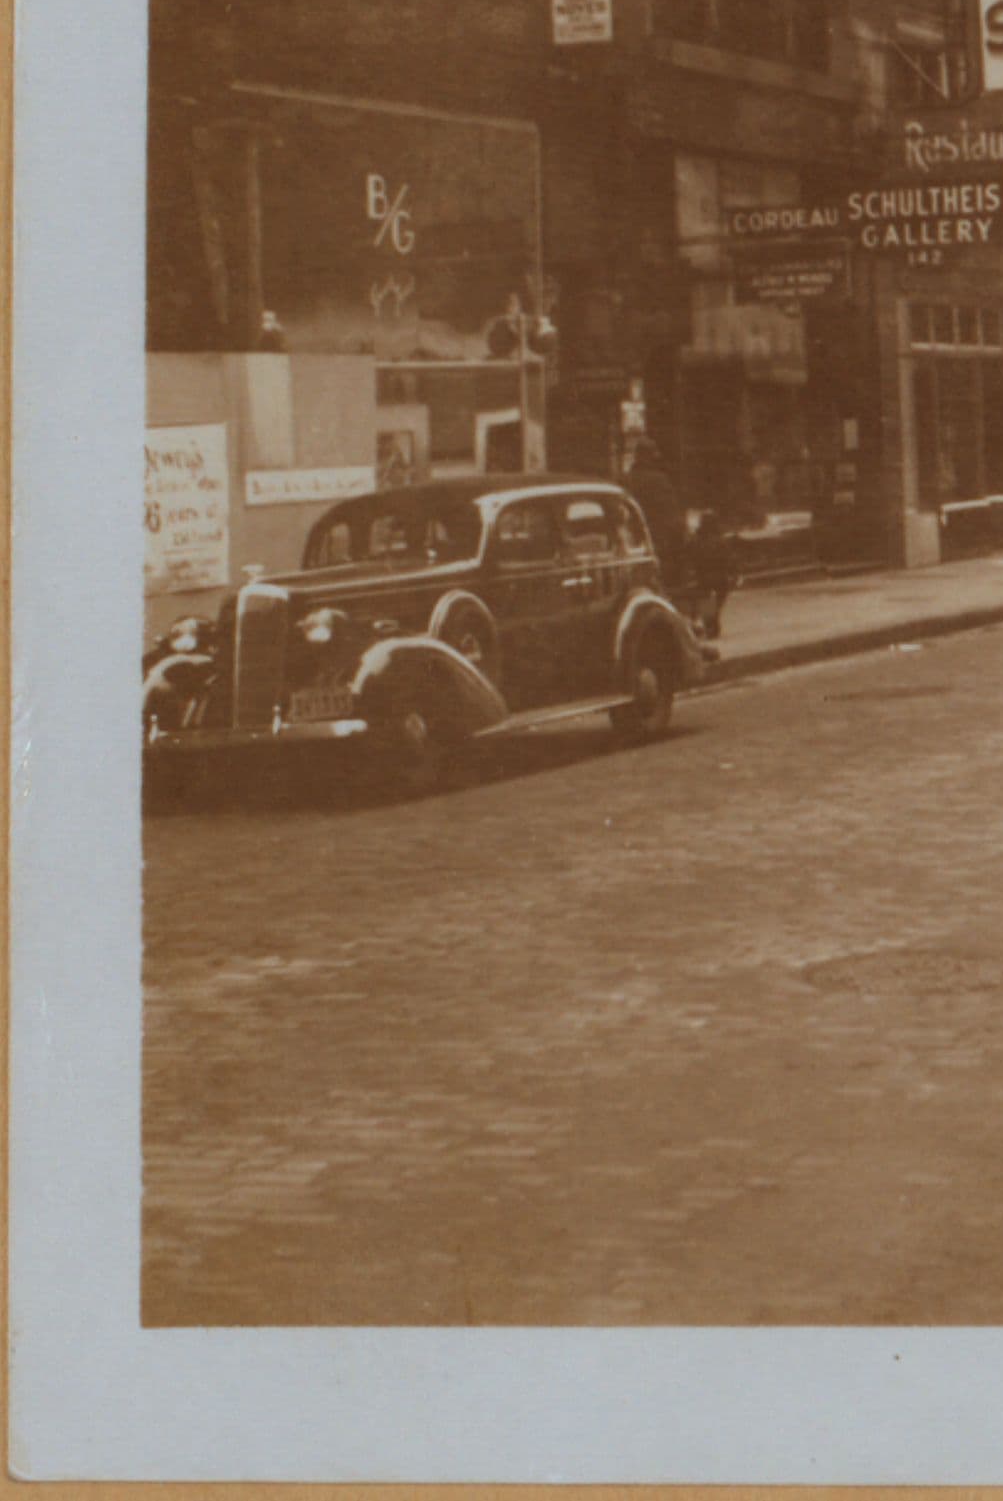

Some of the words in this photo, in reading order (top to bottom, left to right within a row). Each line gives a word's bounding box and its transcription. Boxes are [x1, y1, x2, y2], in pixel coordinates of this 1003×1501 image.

[847, 182, 1001, 221] SCHULTHEIS
[733, 206, 840, 234] CORDEAU
[860, 217, 994, 249] GALLERY
